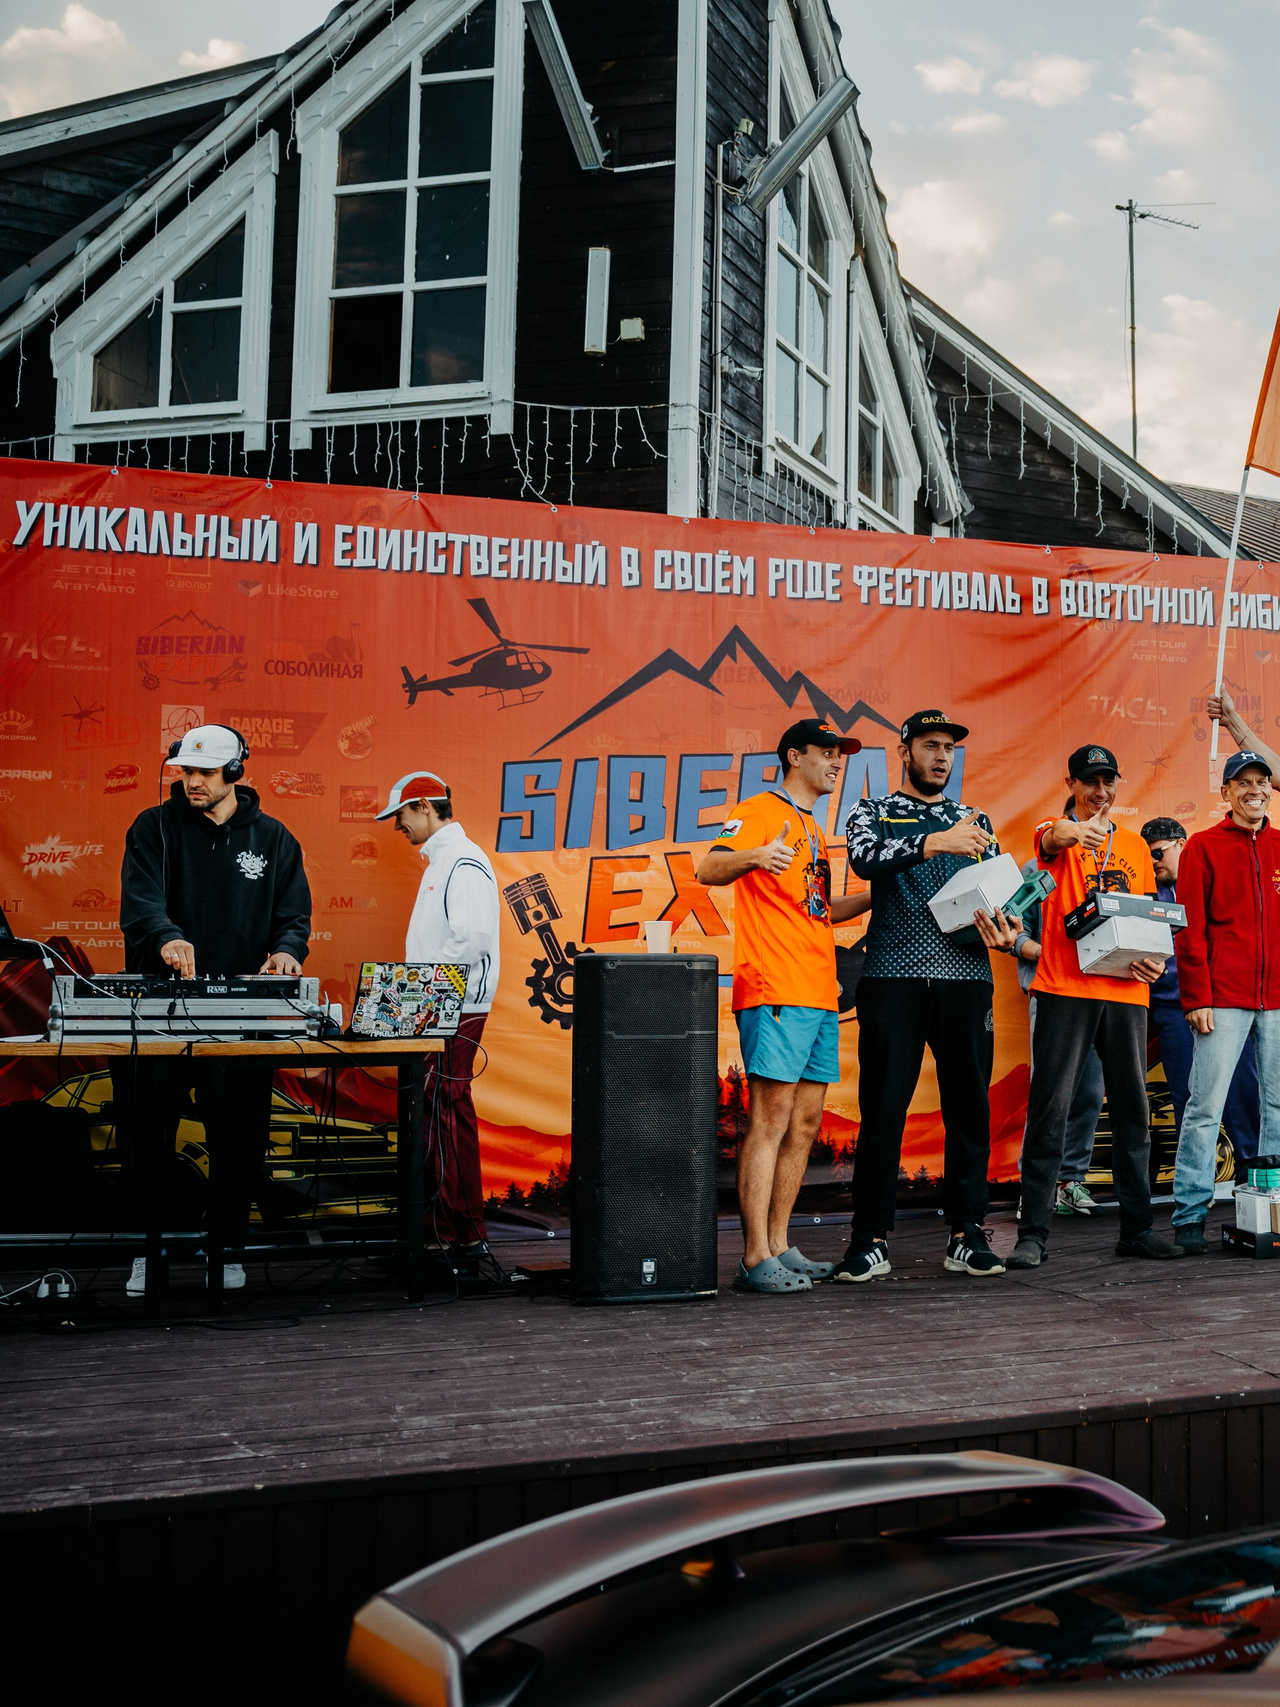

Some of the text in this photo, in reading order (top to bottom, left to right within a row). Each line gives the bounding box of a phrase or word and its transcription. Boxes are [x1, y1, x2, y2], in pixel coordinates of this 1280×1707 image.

[12, 500, 279, 563] УНИКАЛЬНЫЙ
[294, 521, 318, 565] И
[333, 523, 607, 586] ЕДИНСТВЕННЫЙ
[620, 546, 640, 587] В
[654, 549, 755, 597] СВОЁМ
[768, 557, 842, 601] РОДЕ
[852, 564, 1021, 614] ФЕСТИВАЛЬ
[1032, 576, 1049, 615] В
[1060, 578, 1215, 627] ВОСТОЧНОЙ
[52, 563, 137, 577] JETOUR
[266, 583, 340, 599] LikeStore
[1, 631, 103, 662] TAGE+
[135, 634, 245, 655] SIBERIAN
[1131, 639, 1188, 650] JETOUR
[263, 658, 364, 680] СОБОЛИНАЯ
[229, 716, 295, 734] GARAGE
[106, 776, 136, 788] NEON
[24, 848, 71, 867] DRIVE
[1118, 858, 1138, 880] CLUB
[206, 985, 228, 994] RANE
